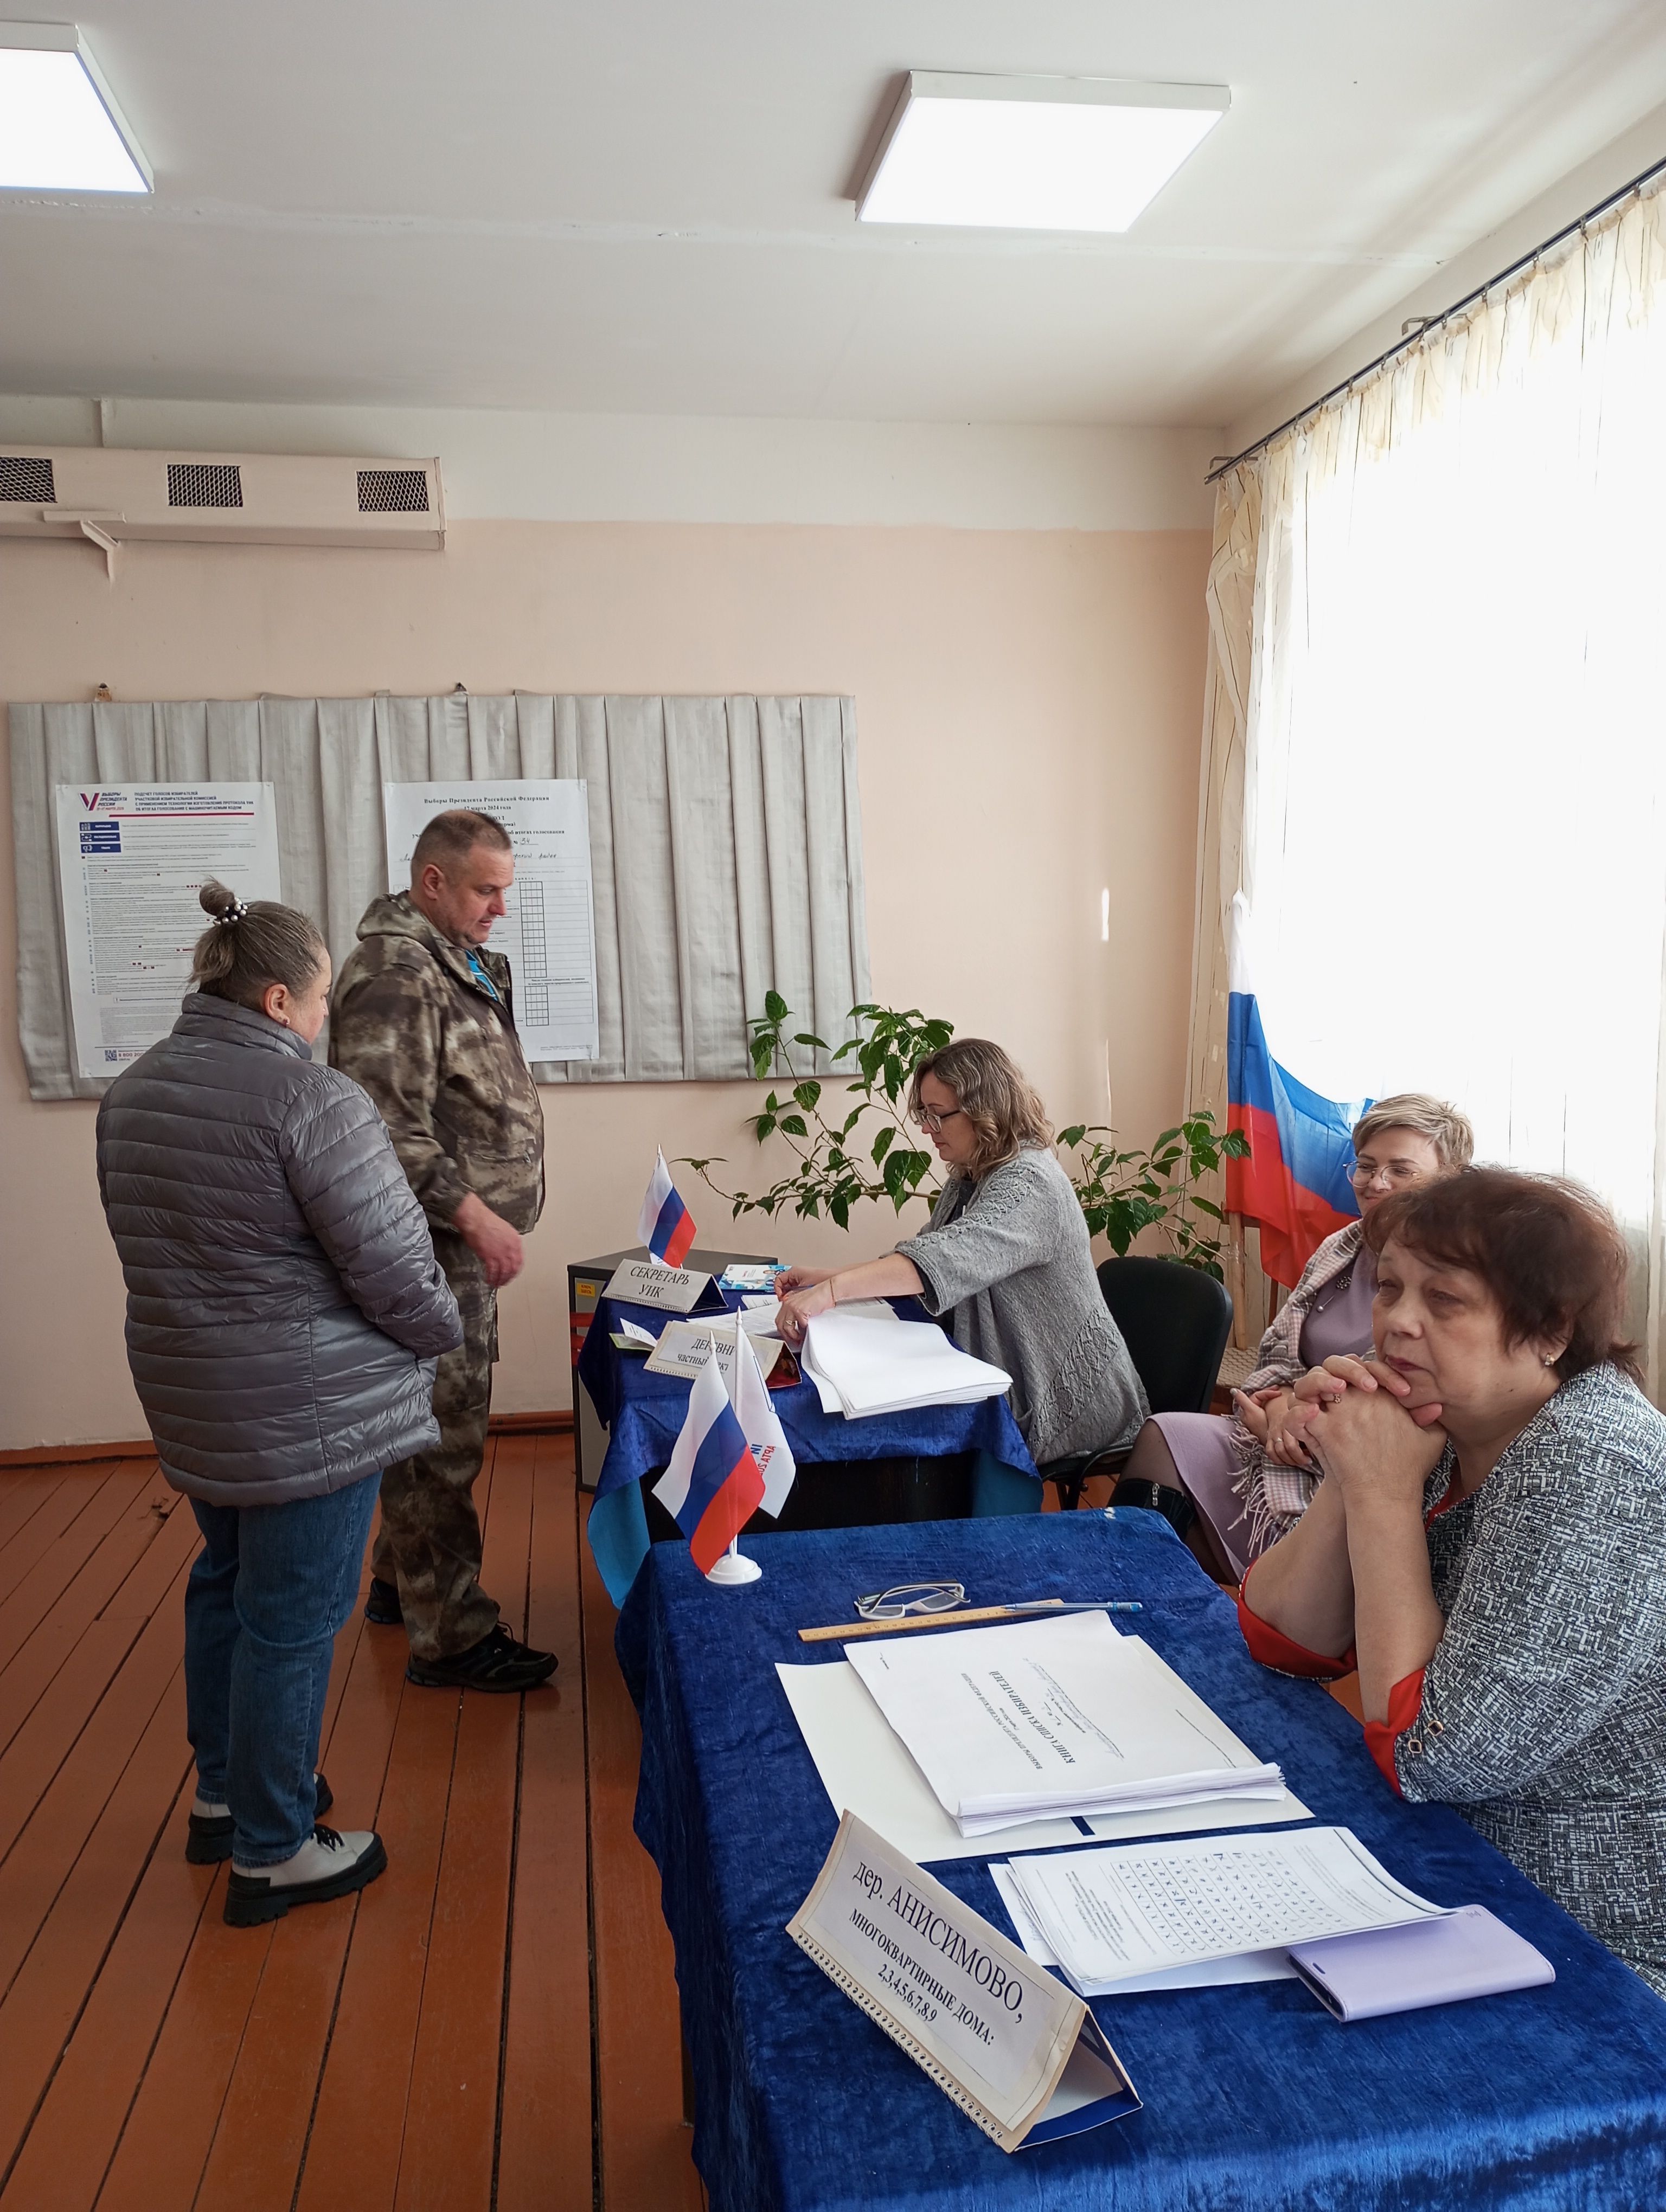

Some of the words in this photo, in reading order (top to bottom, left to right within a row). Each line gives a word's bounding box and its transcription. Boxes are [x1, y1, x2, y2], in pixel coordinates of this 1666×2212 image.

[630, 1266, 689, 1285] СЕКРЕТАРЬ
[638, 1284, 664, 1298] УИК
[988, 1670, 1031, 1715] ИЗБИРАТЕЛЕЙ
[1027, 1715, 1054, 1739] СПИСКА
[1050, 1740, 1076, 1763] КНИГА
[852, 1861, 883, 1900] дер.
[887, 1885, 1023, 2024] АНИСИМОВО,
[849, 1908, 957, 2011] МНОГОКВАРТИРНЫЕ
[952, 2002, 995, 2046] ДОМА:
[877, 1963, 938, 2023] 2,3,4,5,6,7,8,9
